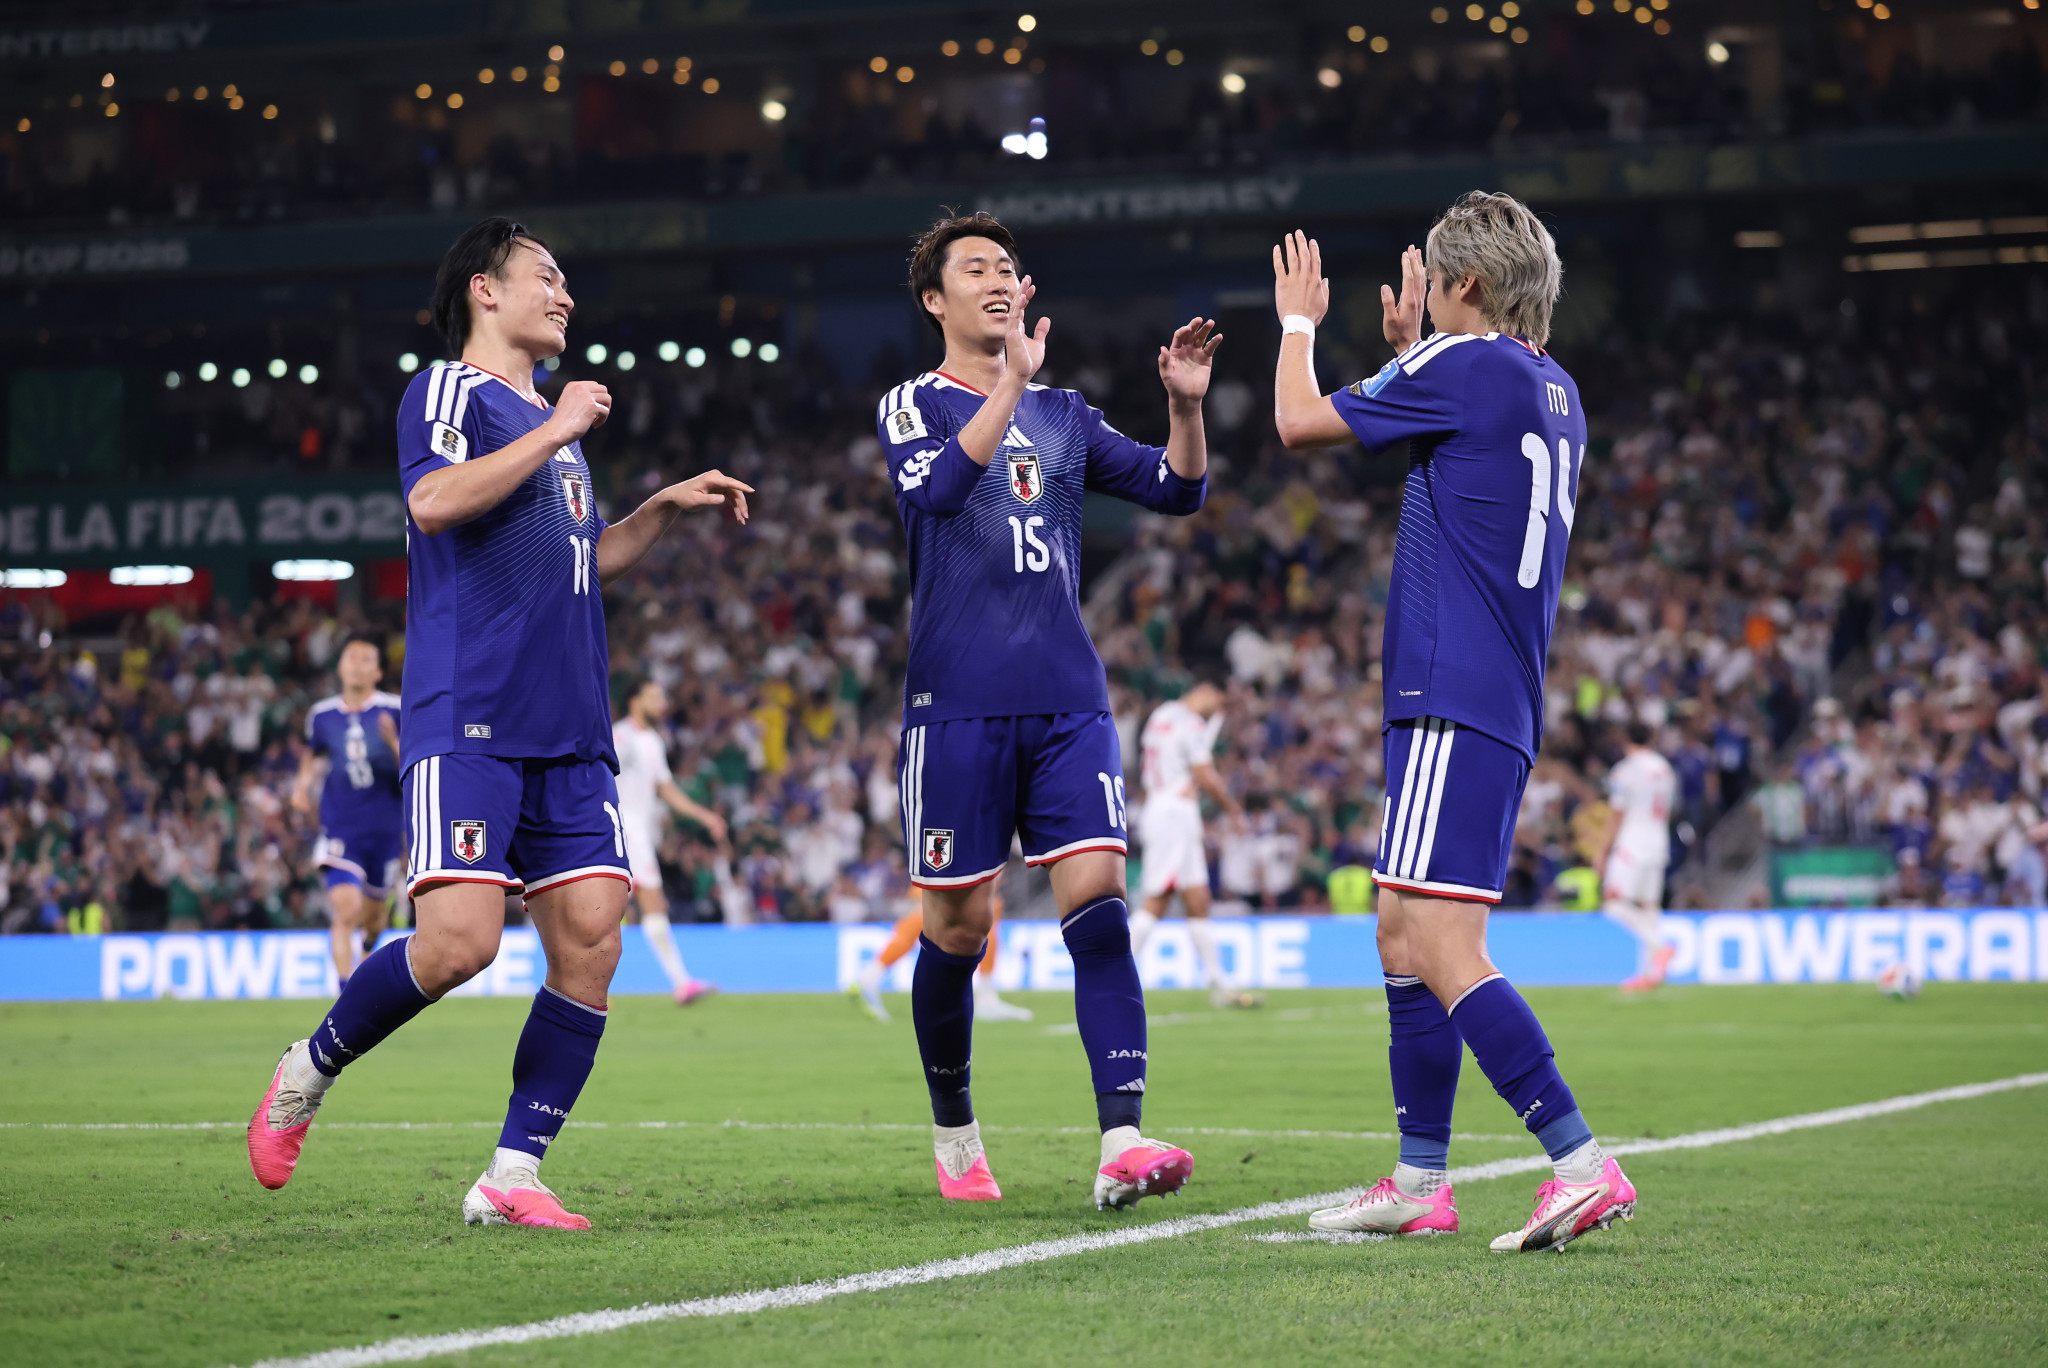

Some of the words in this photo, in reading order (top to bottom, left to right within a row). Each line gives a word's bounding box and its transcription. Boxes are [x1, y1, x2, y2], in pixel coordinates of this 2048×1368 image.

[1546, 381, 1569, 417] ITO
[0, 503, 37, 555] E
[48, 504, 117, 553] LA
[127, 498, 246, 549] FIFA
[1008, 515, 1050, 573] 15
[1097, 771, 1127, 832] 15
[1655, 913, 2048, 984] POWERA
